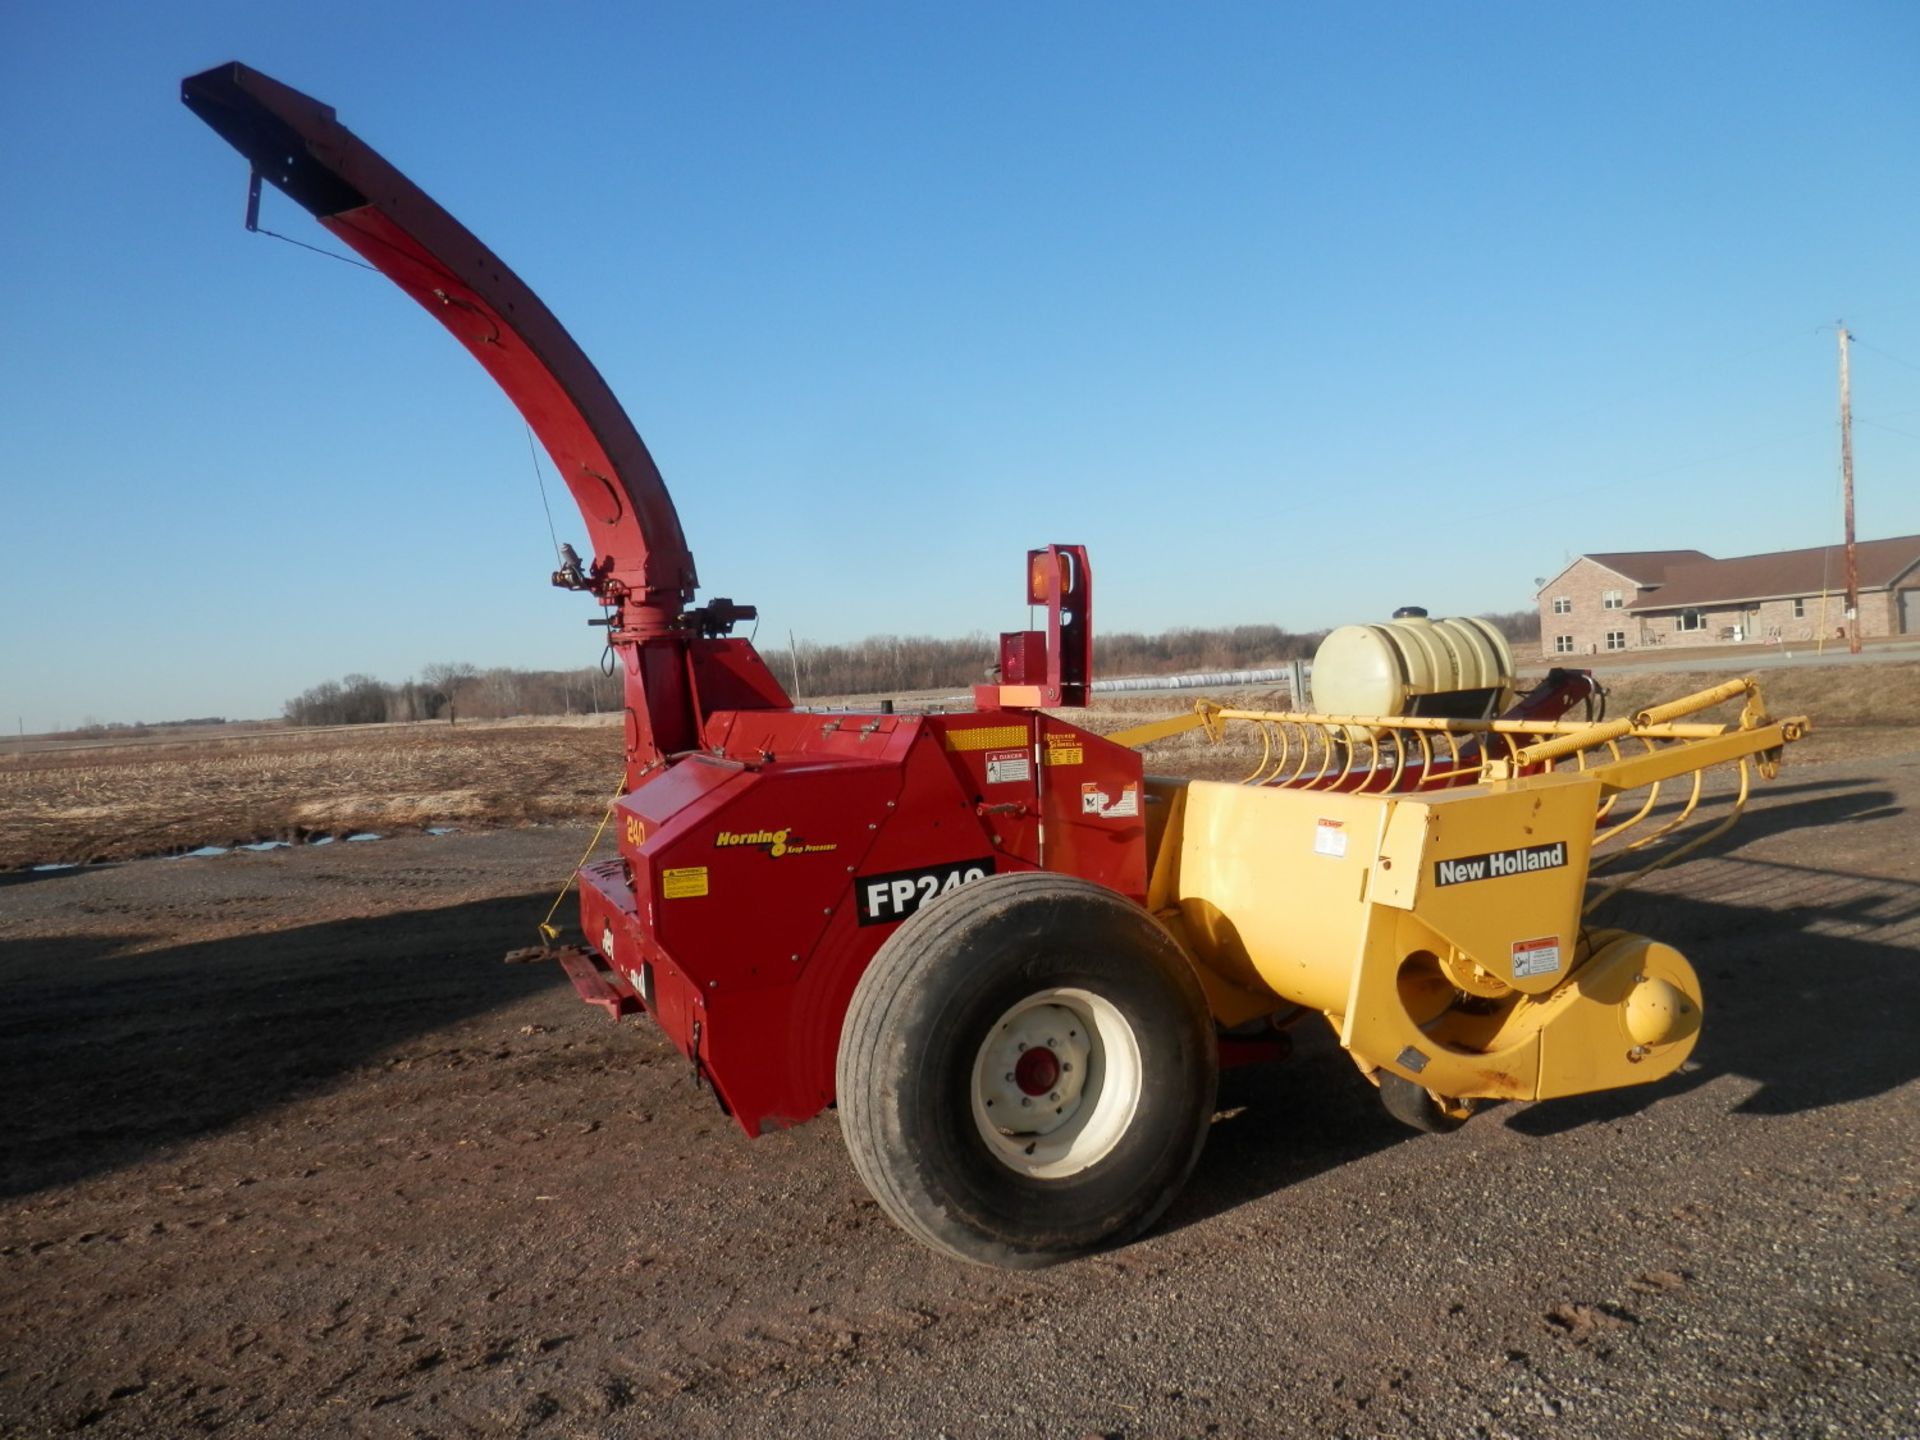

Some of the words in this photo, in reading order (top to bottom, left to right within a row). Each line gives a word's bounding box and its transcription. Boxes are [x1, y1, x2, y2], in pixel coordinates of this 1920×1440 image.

[626, 815, 646, 847] 240
[716, 828, 792, 857] Horning
[1439, 861, 1485, 885] New
[1489, 843, 1563, 877] Holland
